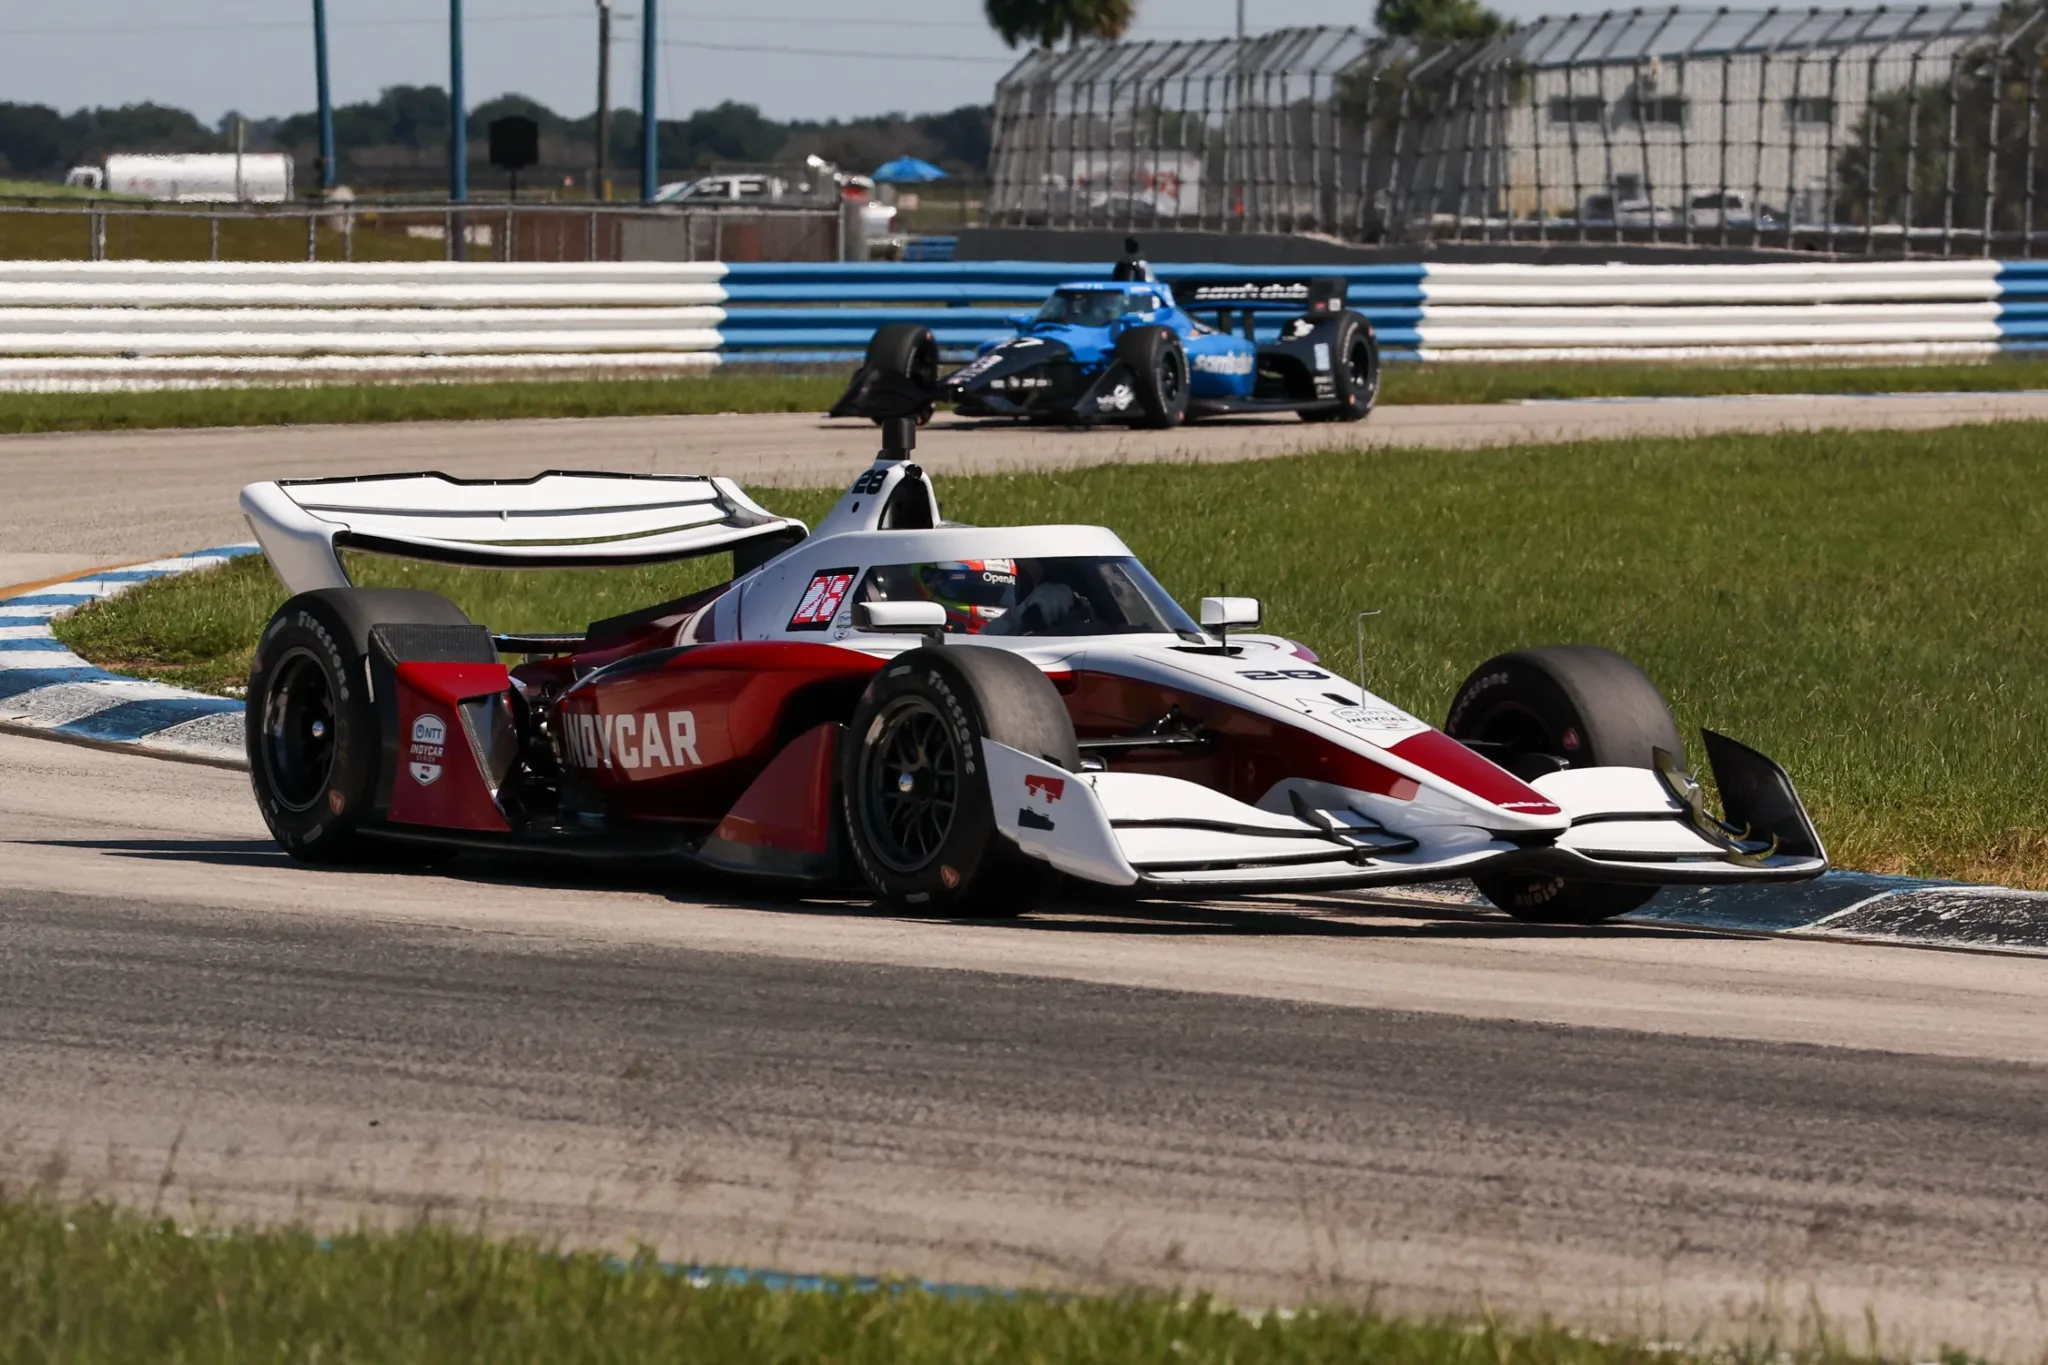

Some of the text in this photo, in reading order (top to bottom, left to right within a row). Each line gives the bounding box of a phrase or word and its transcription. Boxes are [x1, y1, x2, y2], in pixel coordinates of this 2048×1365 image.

[851, 469, 889, 495] 28
[982, 572, 1016, 586] OpenAI
[791, 574, 853, 624] 28
[1234, 669, 1331, 681] 28
[424, 727, 443, 740] NTT
[561, 710, 703, 769] INDYCAR
[410, 743, 444, 757] INDYCAR
